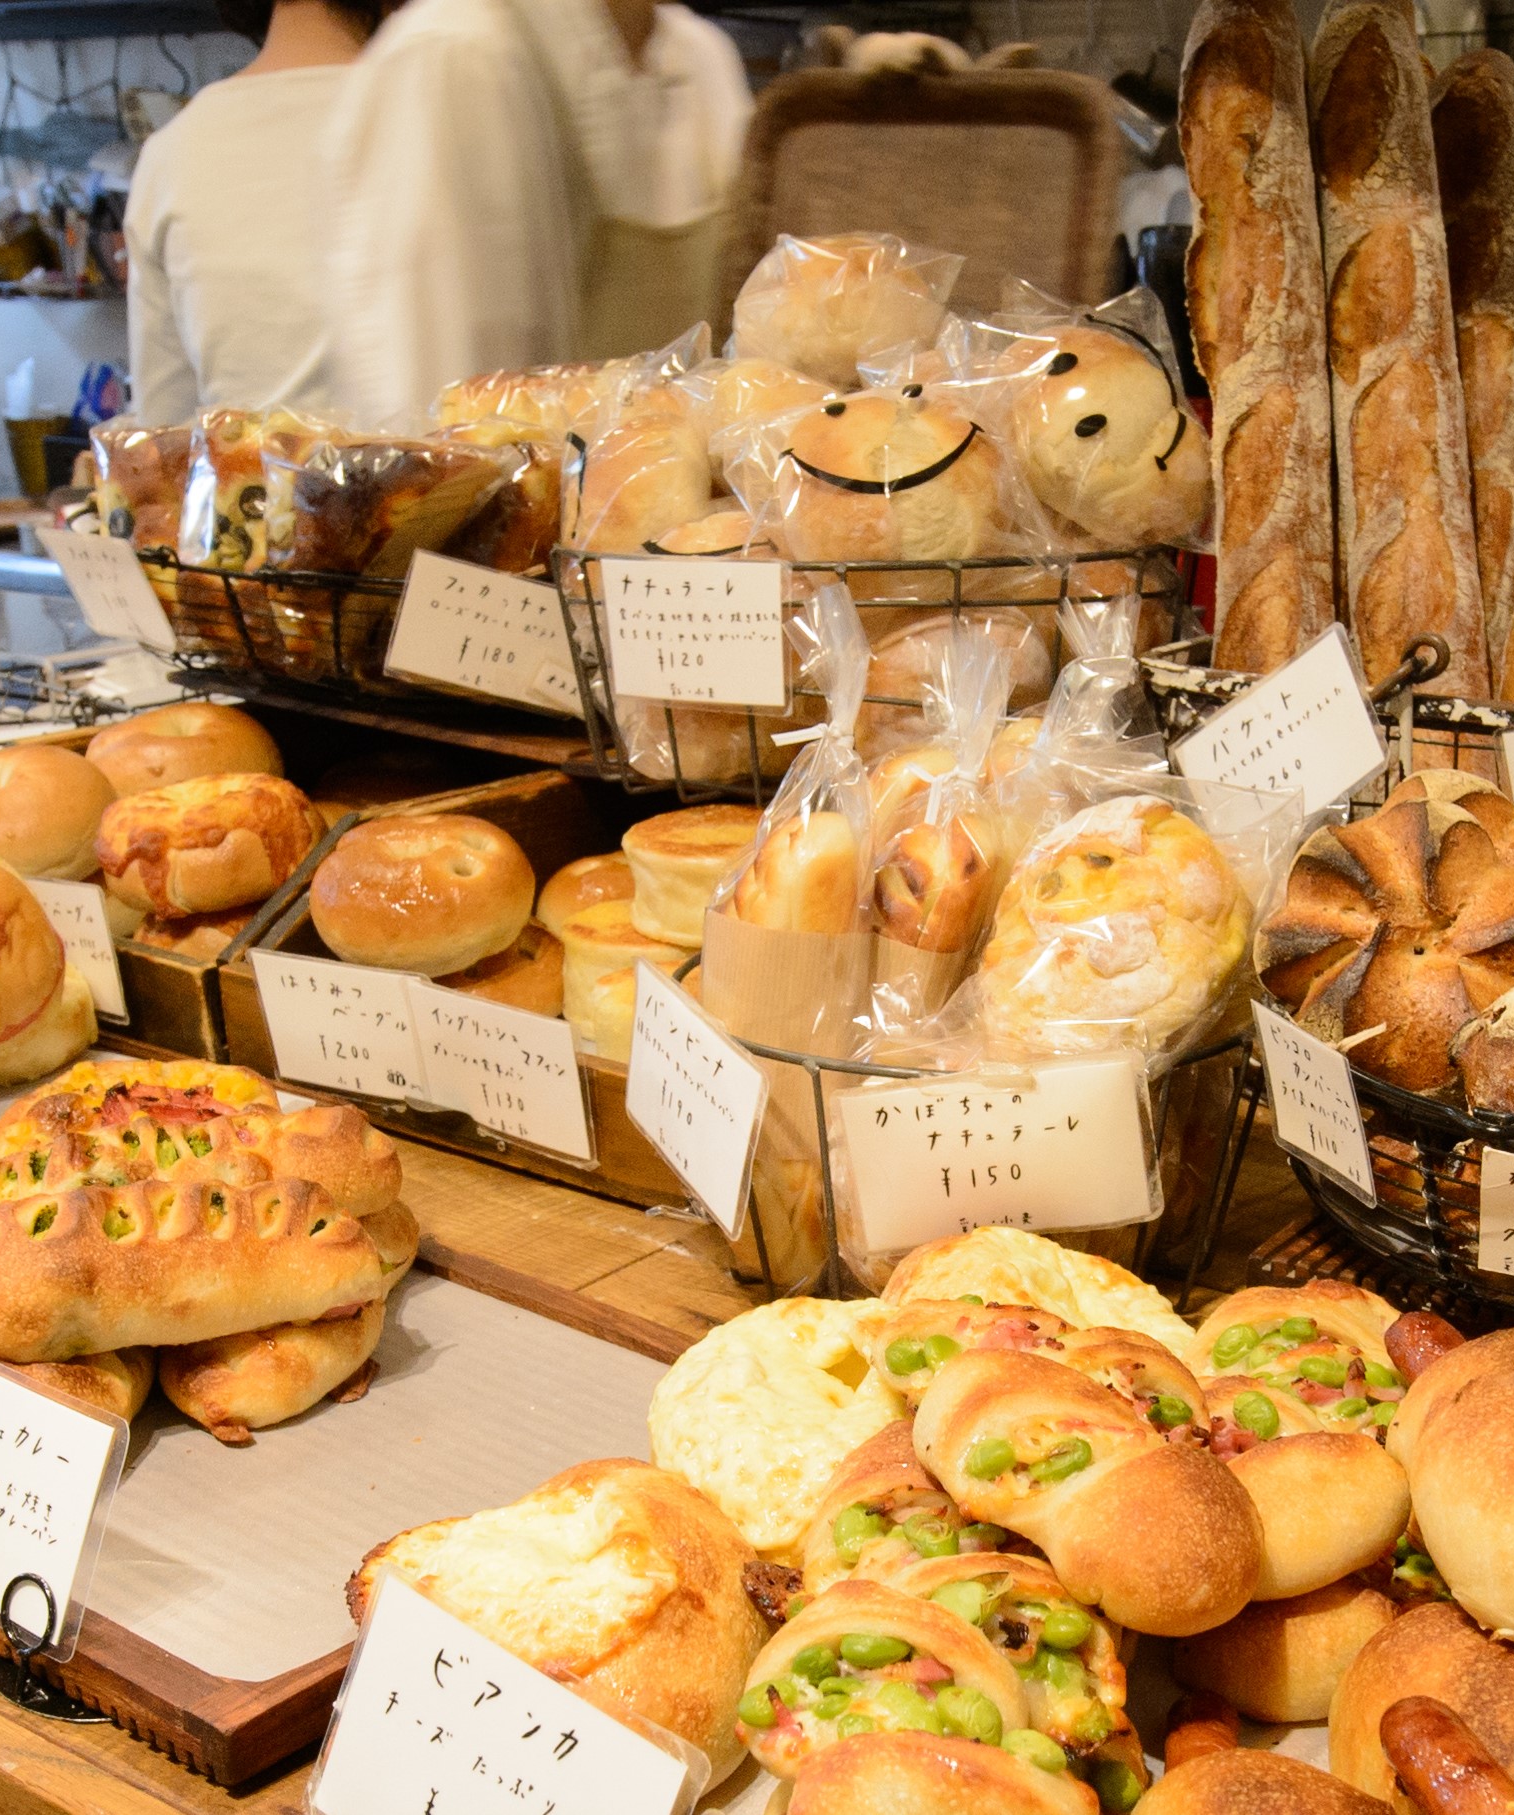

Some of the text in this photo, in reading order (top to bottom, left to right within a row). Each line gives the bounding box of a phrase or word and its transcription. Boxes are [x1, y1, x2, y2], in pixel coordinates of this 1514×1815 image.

[445, 576, 547, 615] フォカッチャ
[622, 574, 735, 598] ナチュラーレ
[458, 635, 515, 664] ¥180
[658, 648, 704, 672] ¥120
[1212, 691, 1292, 762] バケット
[281, 975, 362, 998] はちみつ
[333, 1006, 407, 1032] ベーグル
[431, 1008, 518, 1043] イングリッシュ
[645, 995, 724, 1077] バンビーナ
[319, 1034, 370, 1061] ¥200
[1269, 1024, 1311, 1061] ピッコロ
[521, 1050, 565, 1076] マフィン
[661, 1078, 693, 1125] ¥190
[1292, 1061, 1351, 1109] カンパーニュ
[876, 1094, 1022, 1128] かぼちゃの
[928, 1116, 1079, 1151] ナチュラーレ
[1308, 1122, 1338, 1155] ¥110
[942, 1164, 1022, 1198] ¥150
[434, 1648, 579, 1762] ビアンカ
